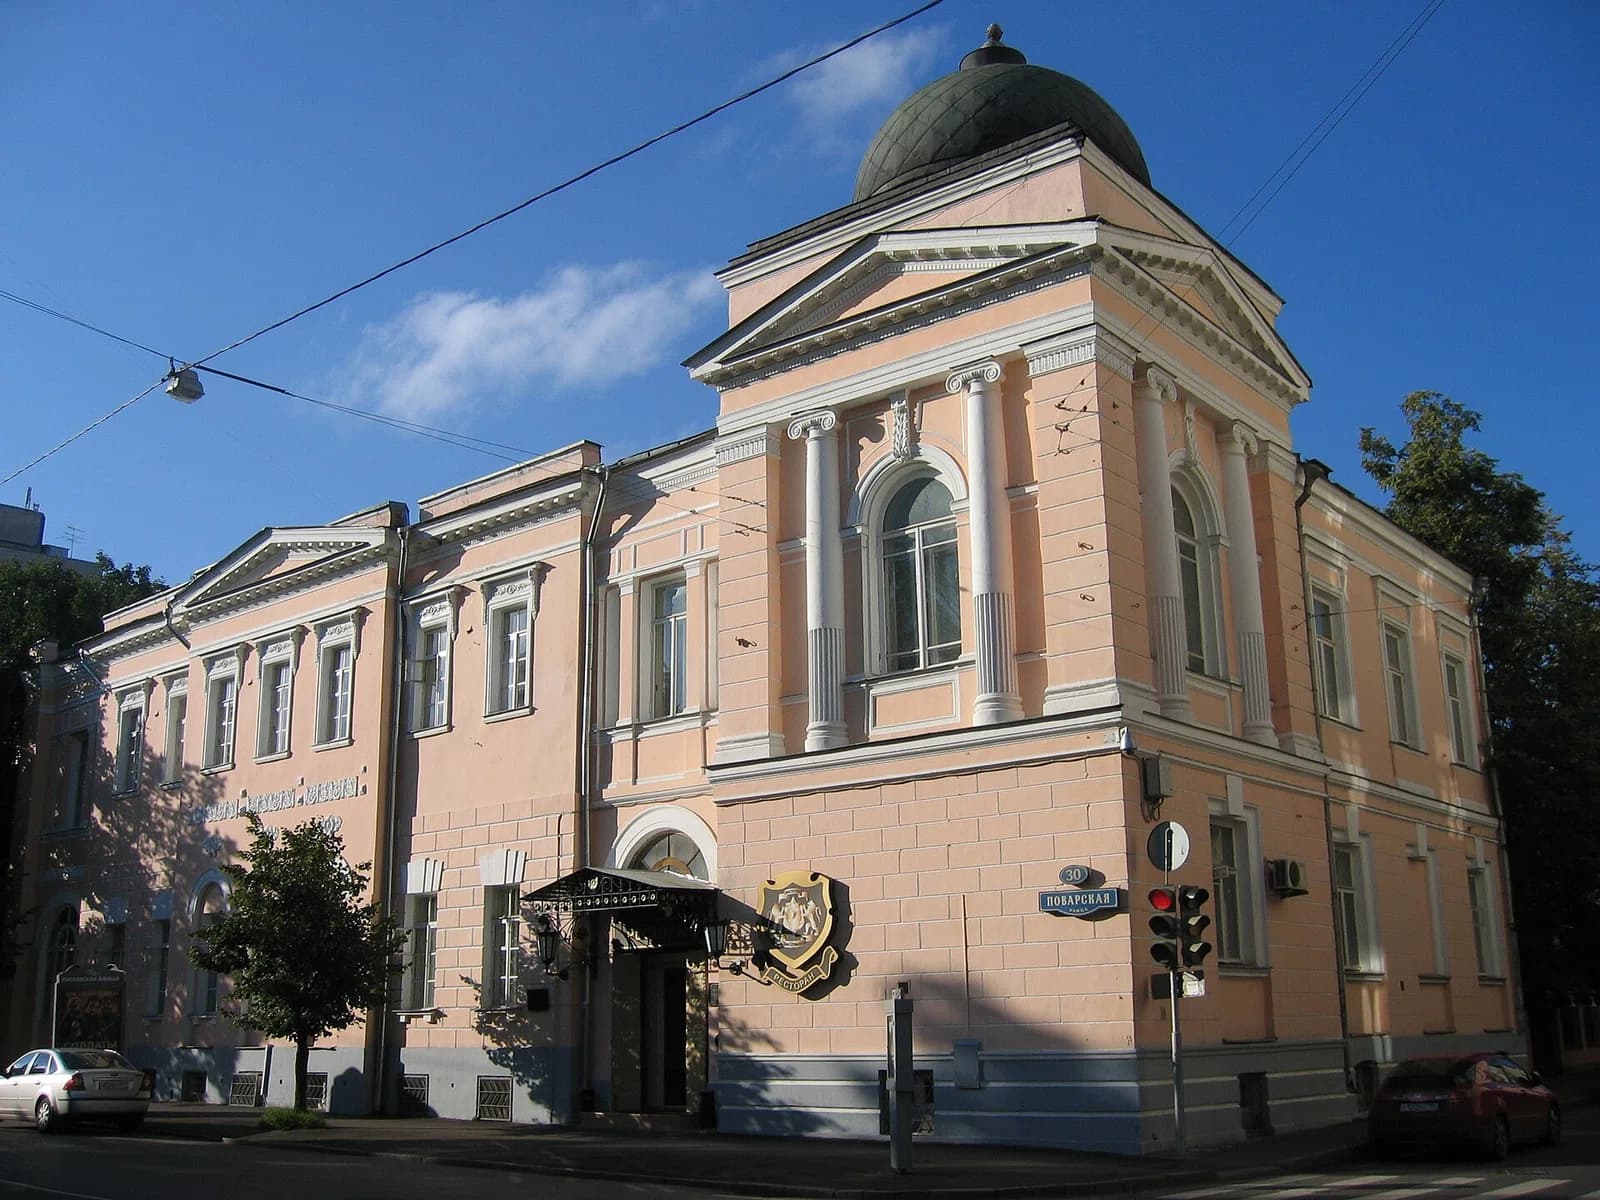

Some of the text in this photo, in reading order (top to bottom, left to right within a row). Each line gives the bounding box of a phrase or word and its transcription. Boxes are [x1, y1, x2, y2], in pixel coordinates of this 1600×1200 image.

[1065, 868, 1082, 882] 30
[1047, 893, 1110, 907] ПОВАРСКАЯ
[772, 971, 816, 990] РЕСТОРАН
